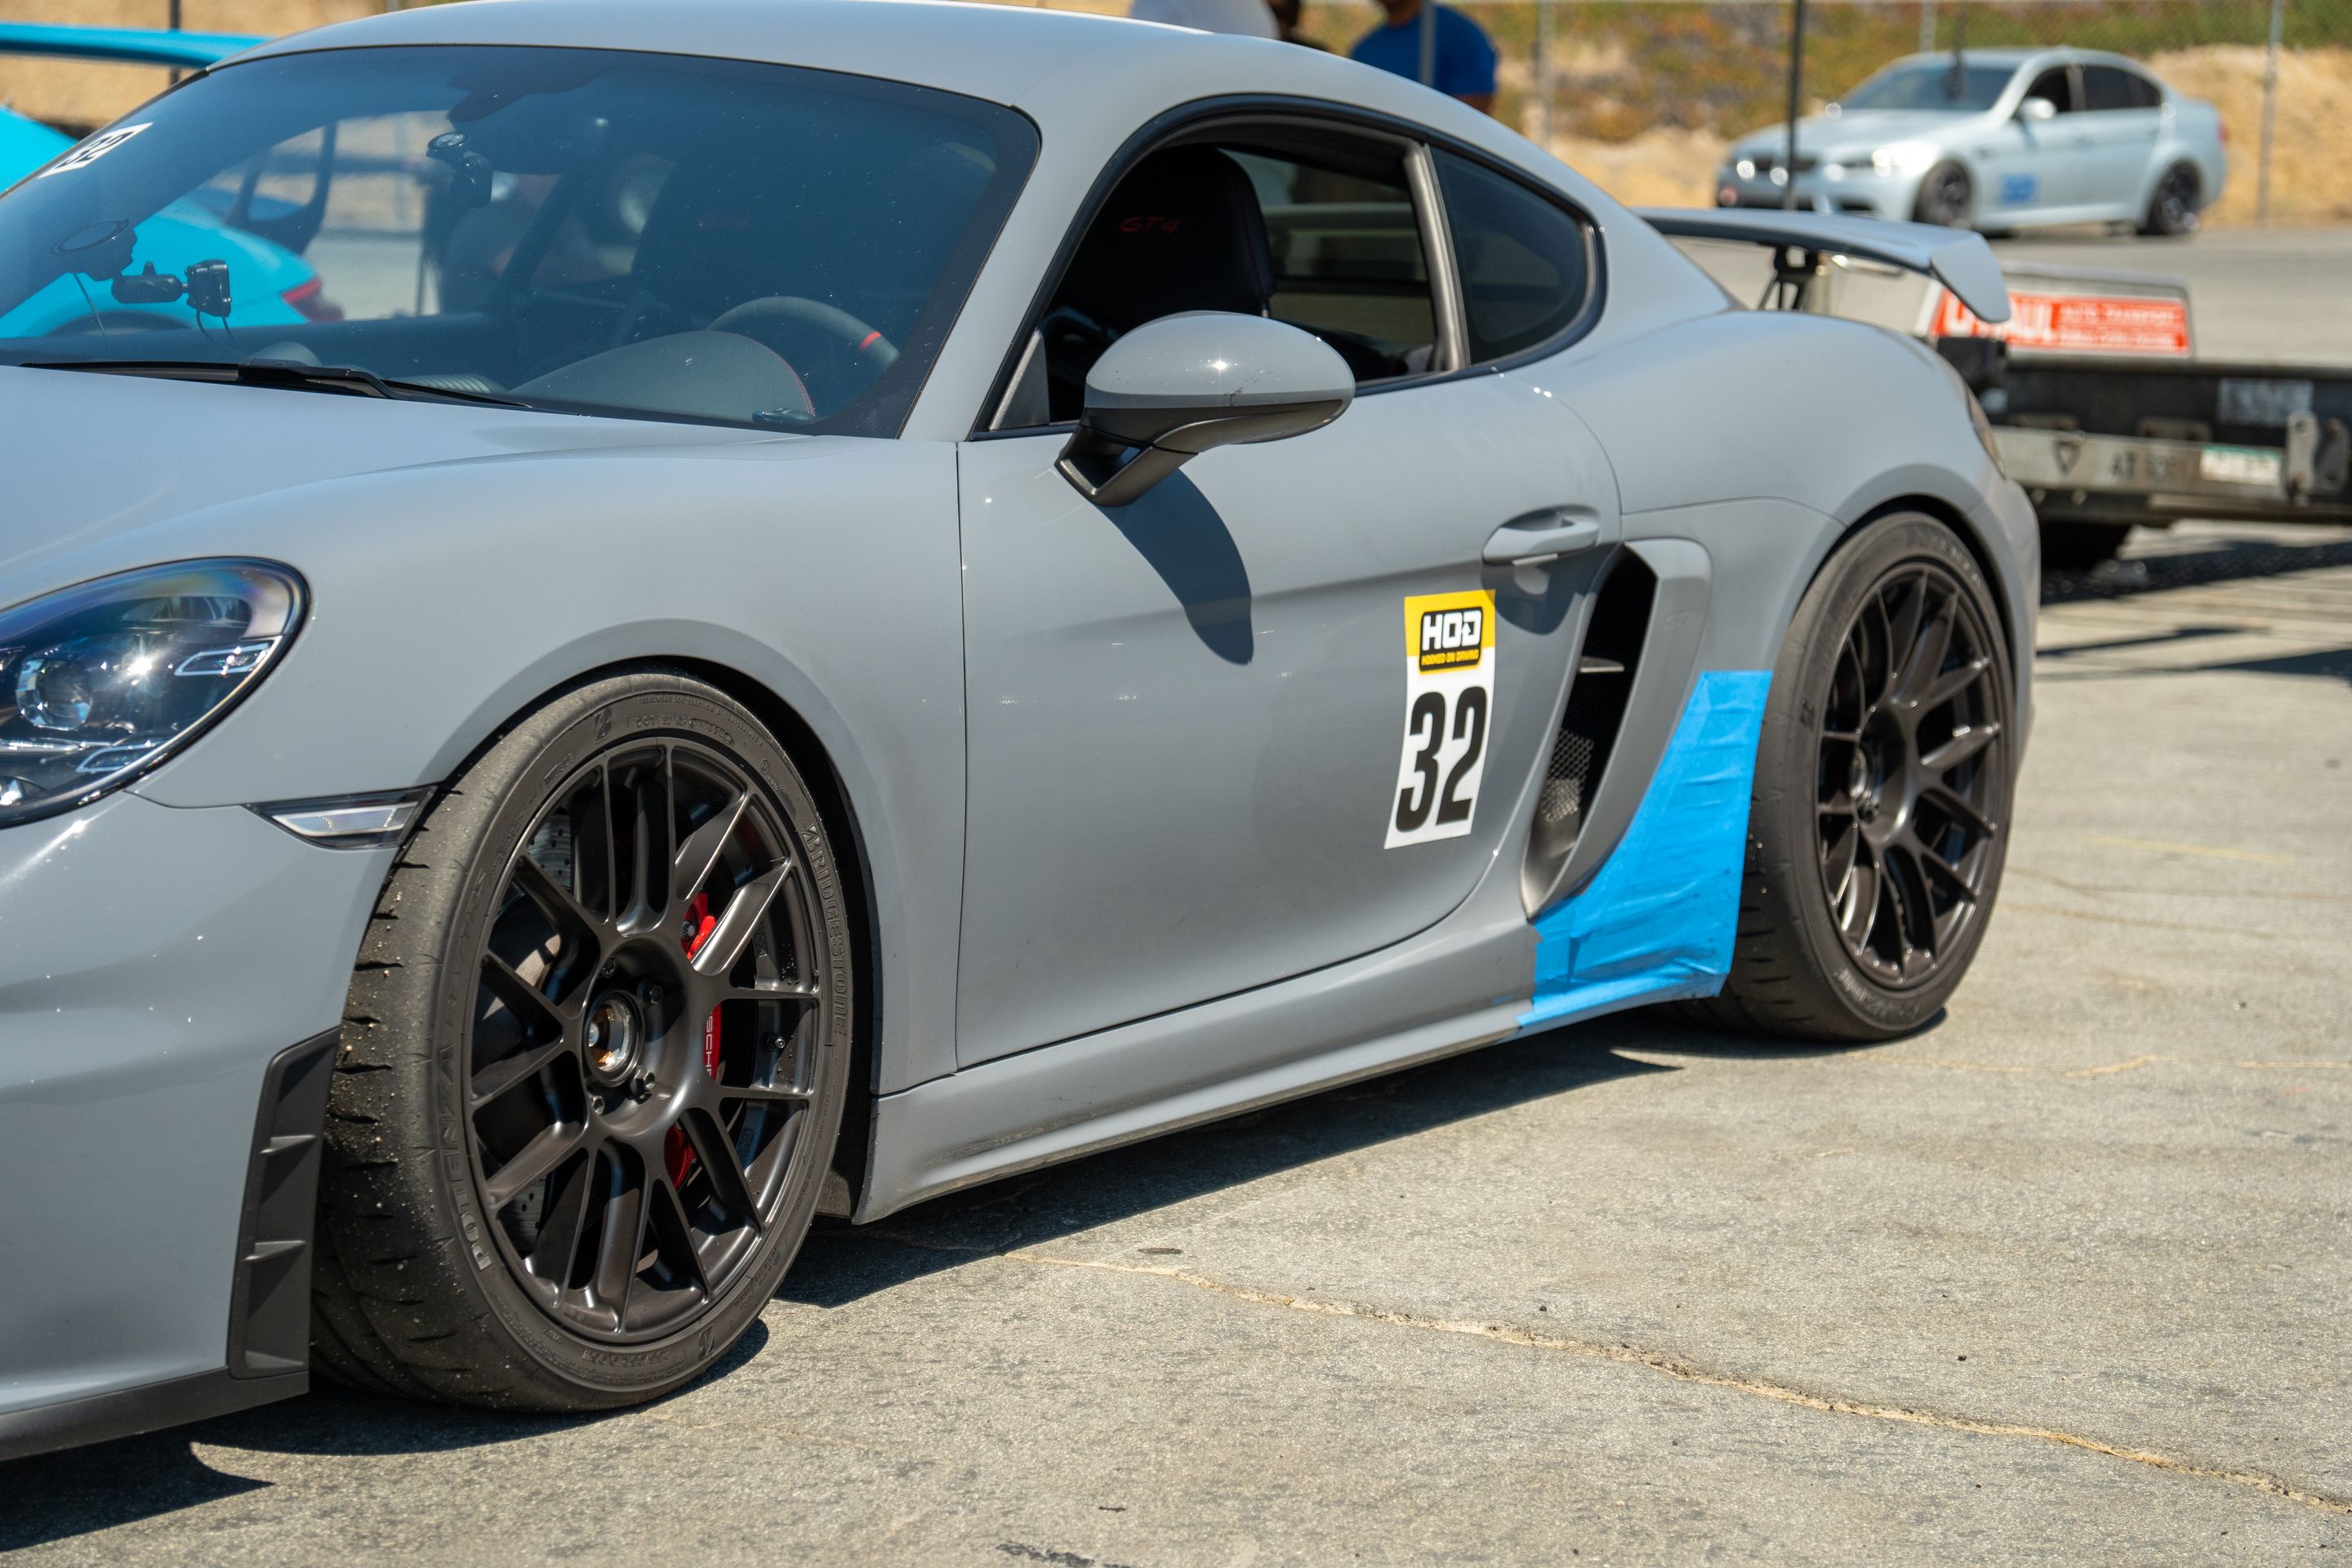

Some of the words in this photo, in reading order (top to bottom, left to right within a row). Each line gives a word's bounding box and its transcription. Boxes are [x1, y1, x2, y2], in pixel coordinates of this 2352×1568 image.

[54, 131, 135, 169] 32
[1119, 216, 1180, 234] GT4
[1422, 610, 1482, 651] HOD
[1396, 686, 1487, 832] 32
[801, 823, 849, 1036] BRIDGESTONE
[439, 1045, 492, 1272] POTENZA
